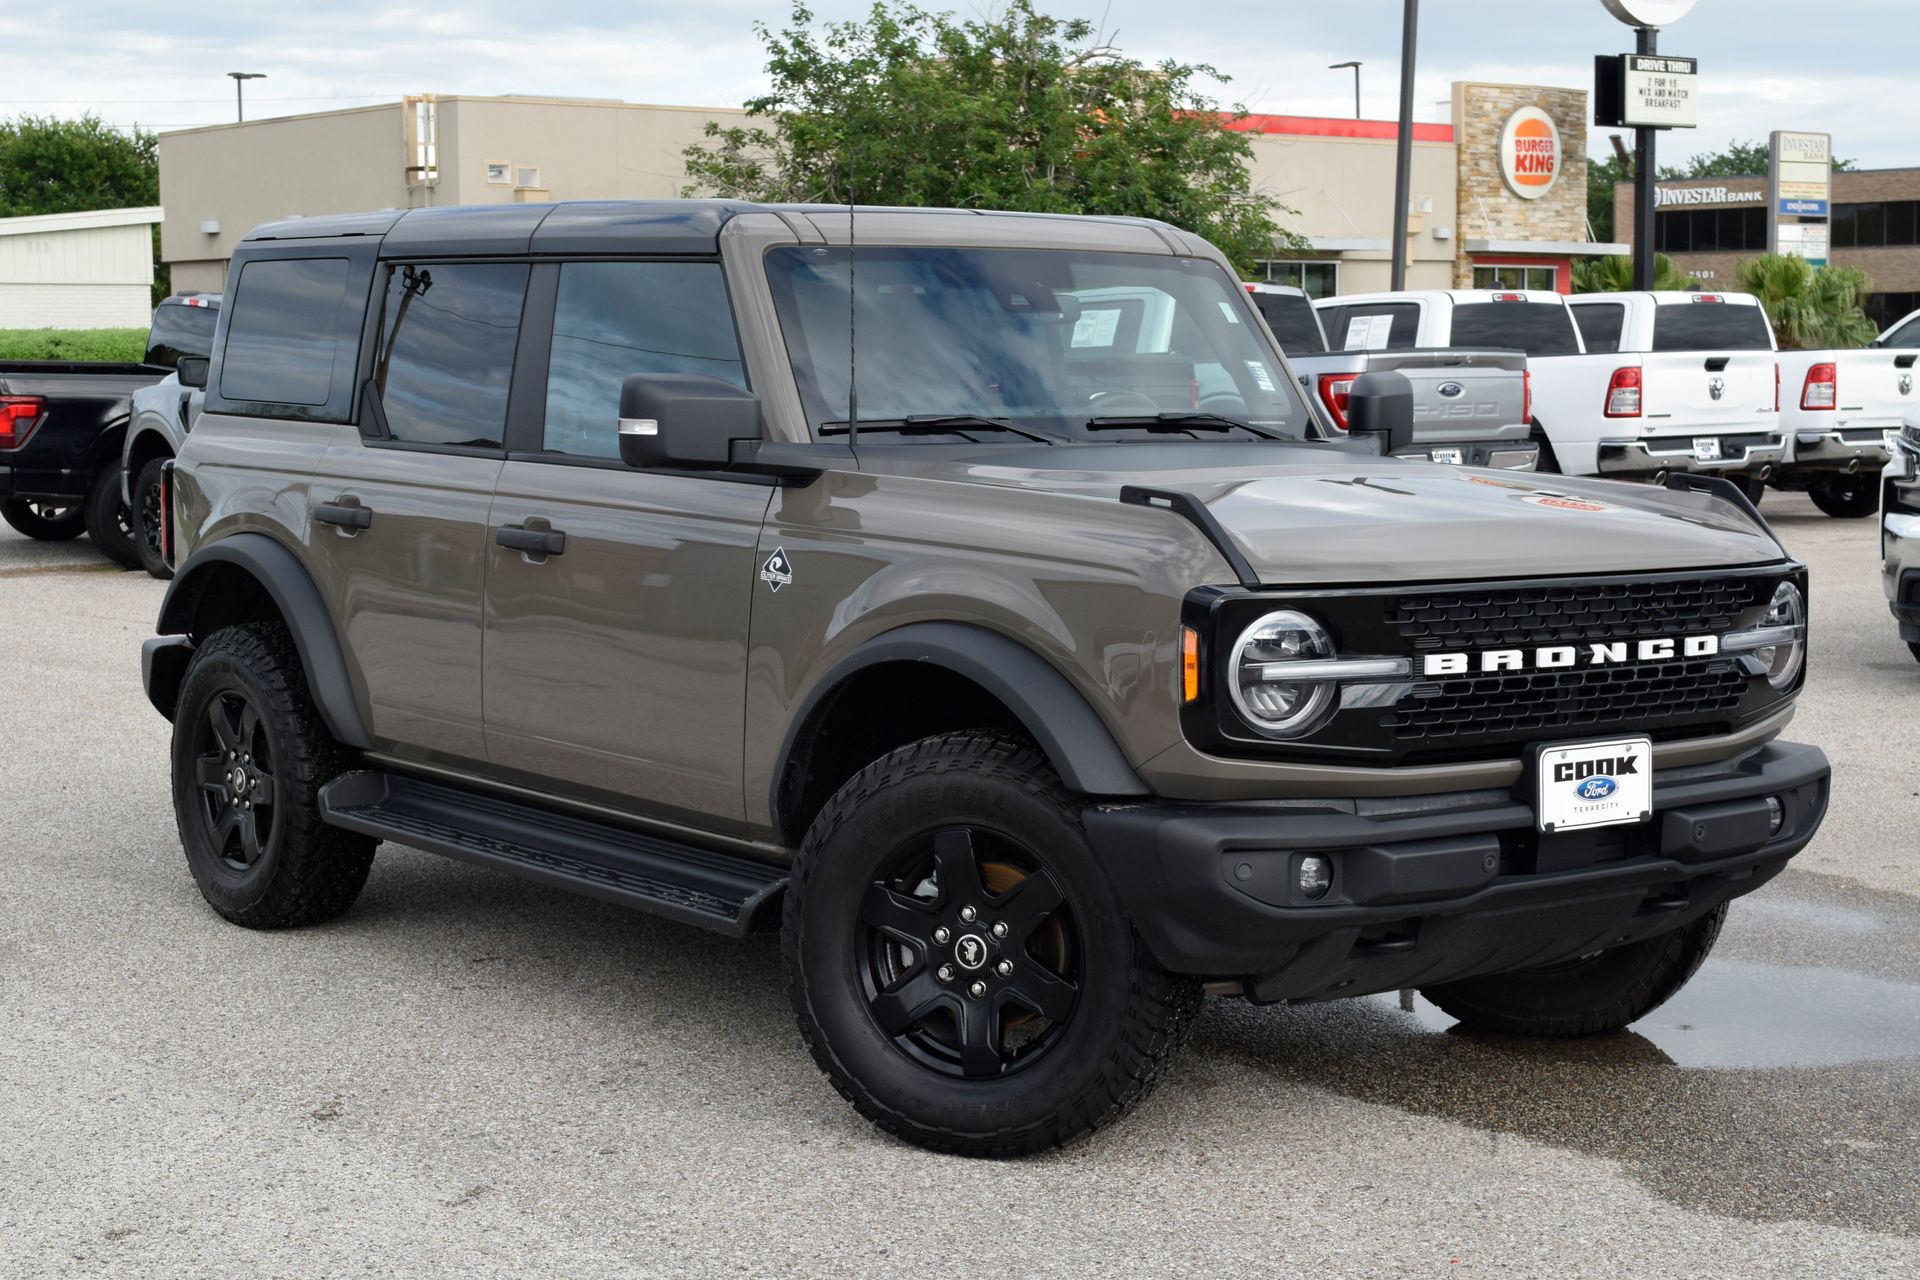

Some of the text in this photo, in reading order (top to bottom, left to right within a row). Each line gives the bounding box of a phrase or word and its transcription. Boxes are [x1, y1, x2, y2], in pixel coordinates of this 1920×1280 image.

[1636, 59, 1691, 73] DRIVE THRU
[1654, 78, 1666, 87] FOR
[1639, 88, 1688, 98] MIX AND MATCH
[1645, 98, 1681, 108] BREAKFAST
[1515, 139, 1554, 153] BURGER
[1783, 136, 1825, 152] INVESTAR
[1515, 154, 1554, 173] KING
[1660, 187, 1763, 205] INVESTAR BANK
[1424, 634, 1718, 675] BRONCO
[1554, 755, 1638, 783] COOK
[1584, 780, 1609, 797] Ford
